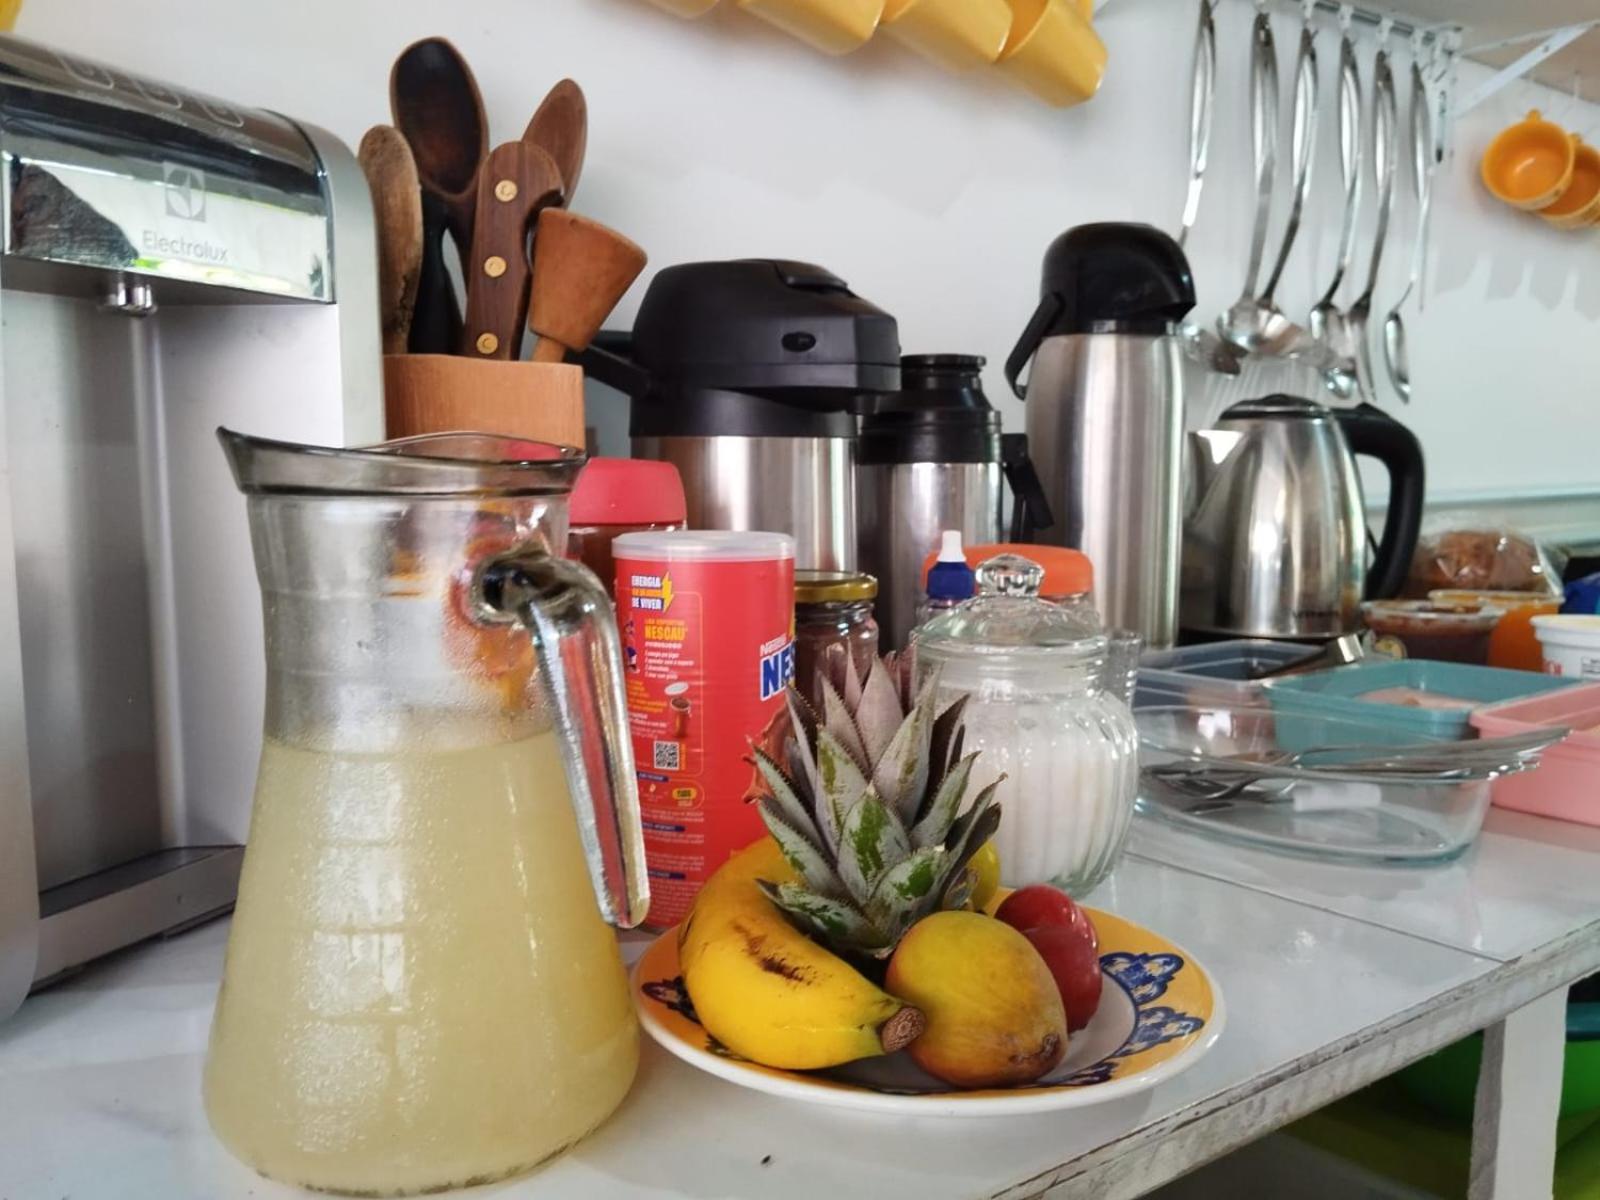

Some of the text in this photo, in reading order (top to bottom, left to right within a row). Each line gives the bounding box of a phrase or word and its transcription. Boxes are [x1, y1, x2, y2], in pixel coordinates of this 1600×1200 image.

[142, 230, 229, 262] Electrolux
[640, 597, 662, 610] VIVER
[644, 625, 686, 640] NESCAU
